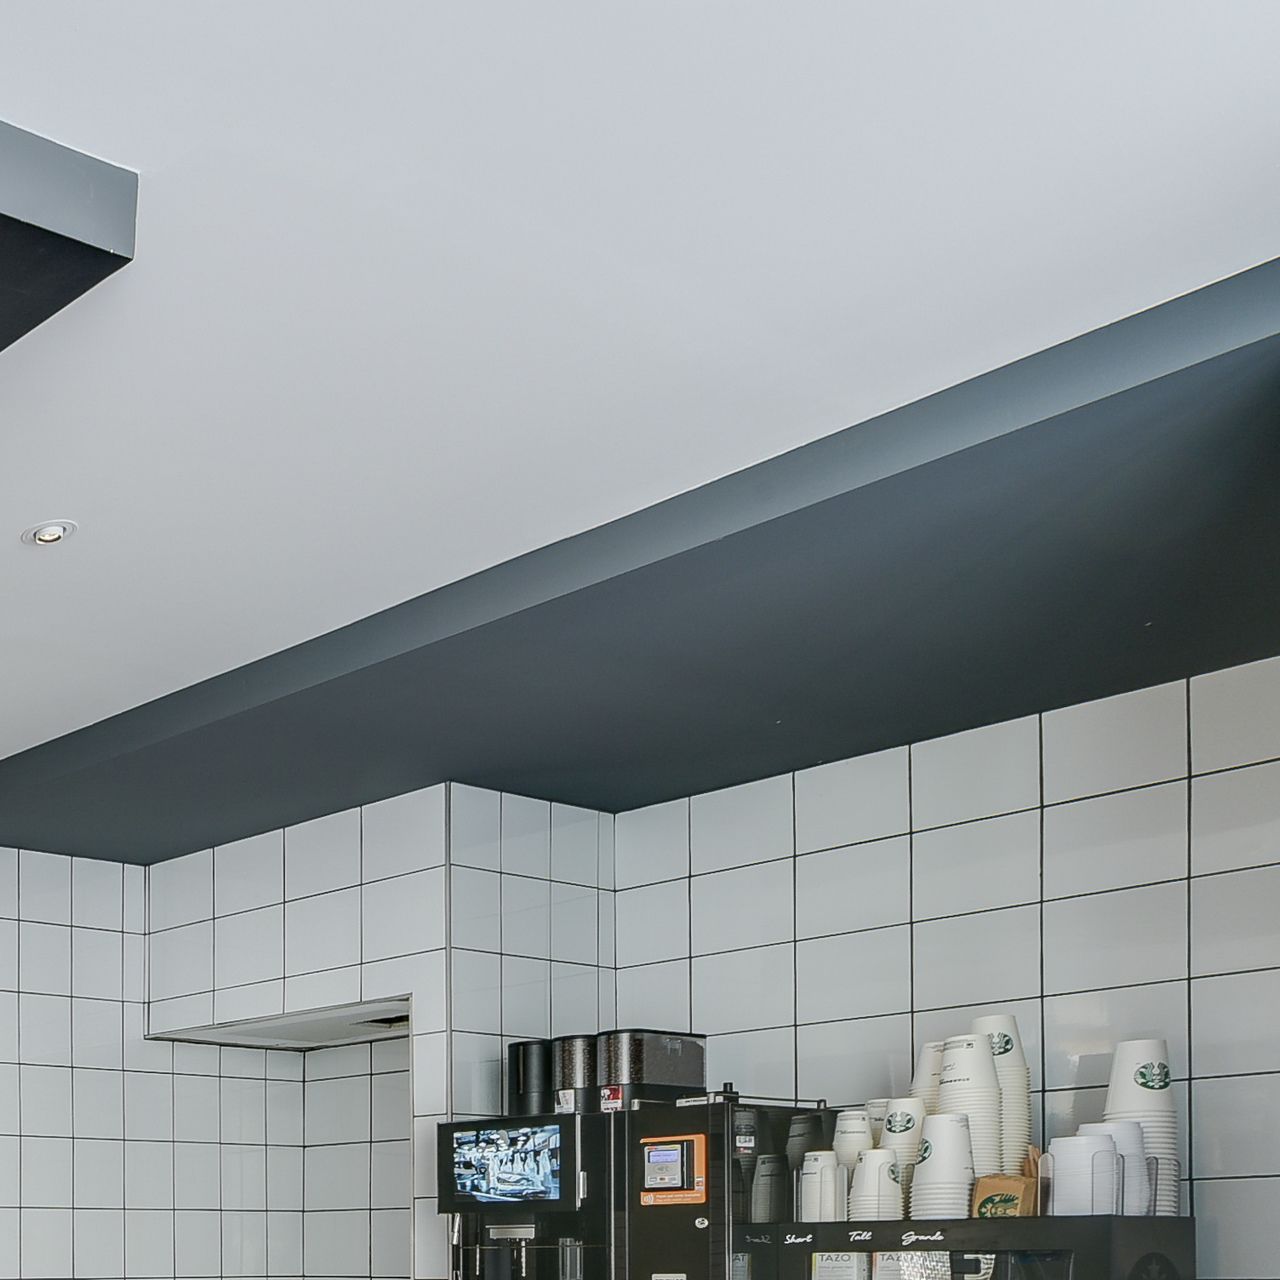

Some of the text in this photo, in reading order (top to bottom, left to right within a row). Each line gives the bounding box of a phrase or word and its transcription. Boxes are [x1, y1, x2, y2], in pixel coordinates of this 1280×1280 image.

[784, 1234, 812, 1244] Short
[848, 1230, 872, 1242] Tall
[901, 1231, 944, 1246] Grande
[819, 1254, 851, 1262] TAZO
